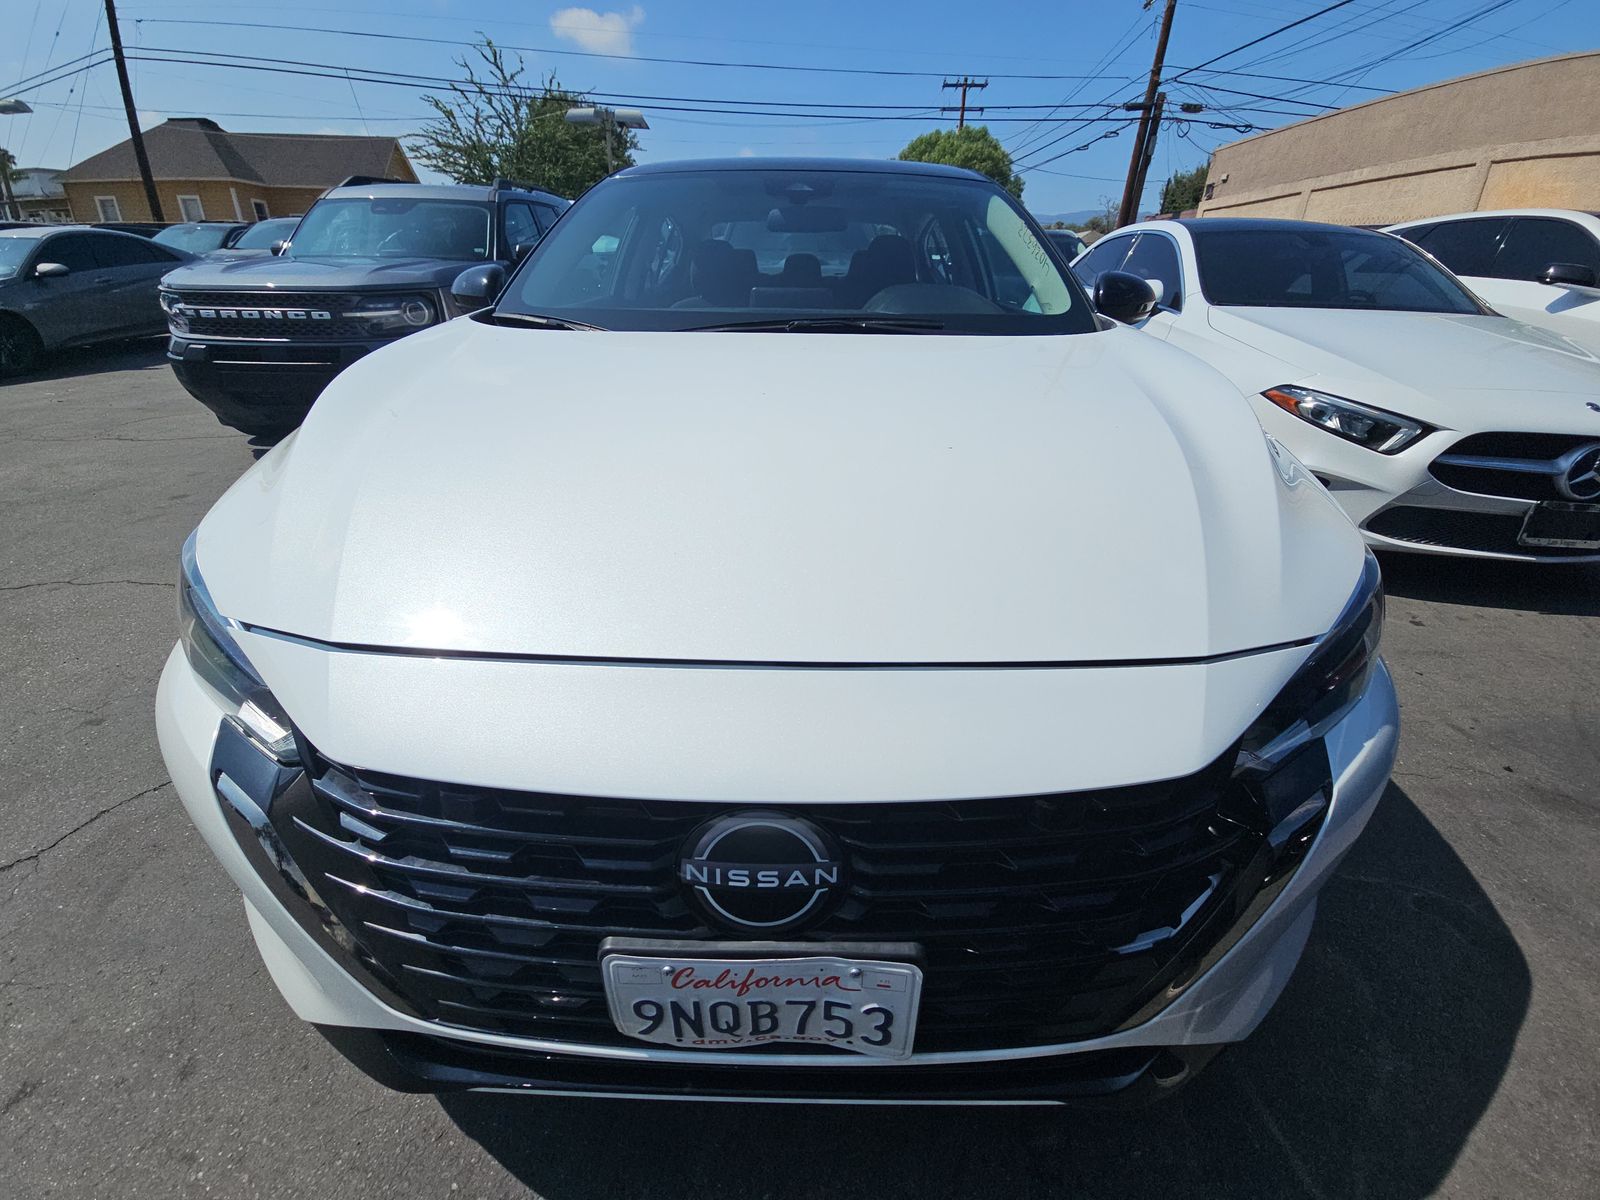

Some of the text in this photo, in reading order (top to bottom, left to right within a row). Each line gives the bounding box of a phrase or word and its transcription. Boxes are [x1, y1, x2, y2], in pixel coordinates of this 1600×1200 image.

[199, 309, 331, 320] BRONCO
[685, 863, 838, 888] NISSAN
[671, 966, 862, 997] California
[632, 999, 895, 1047] 9NQB753
